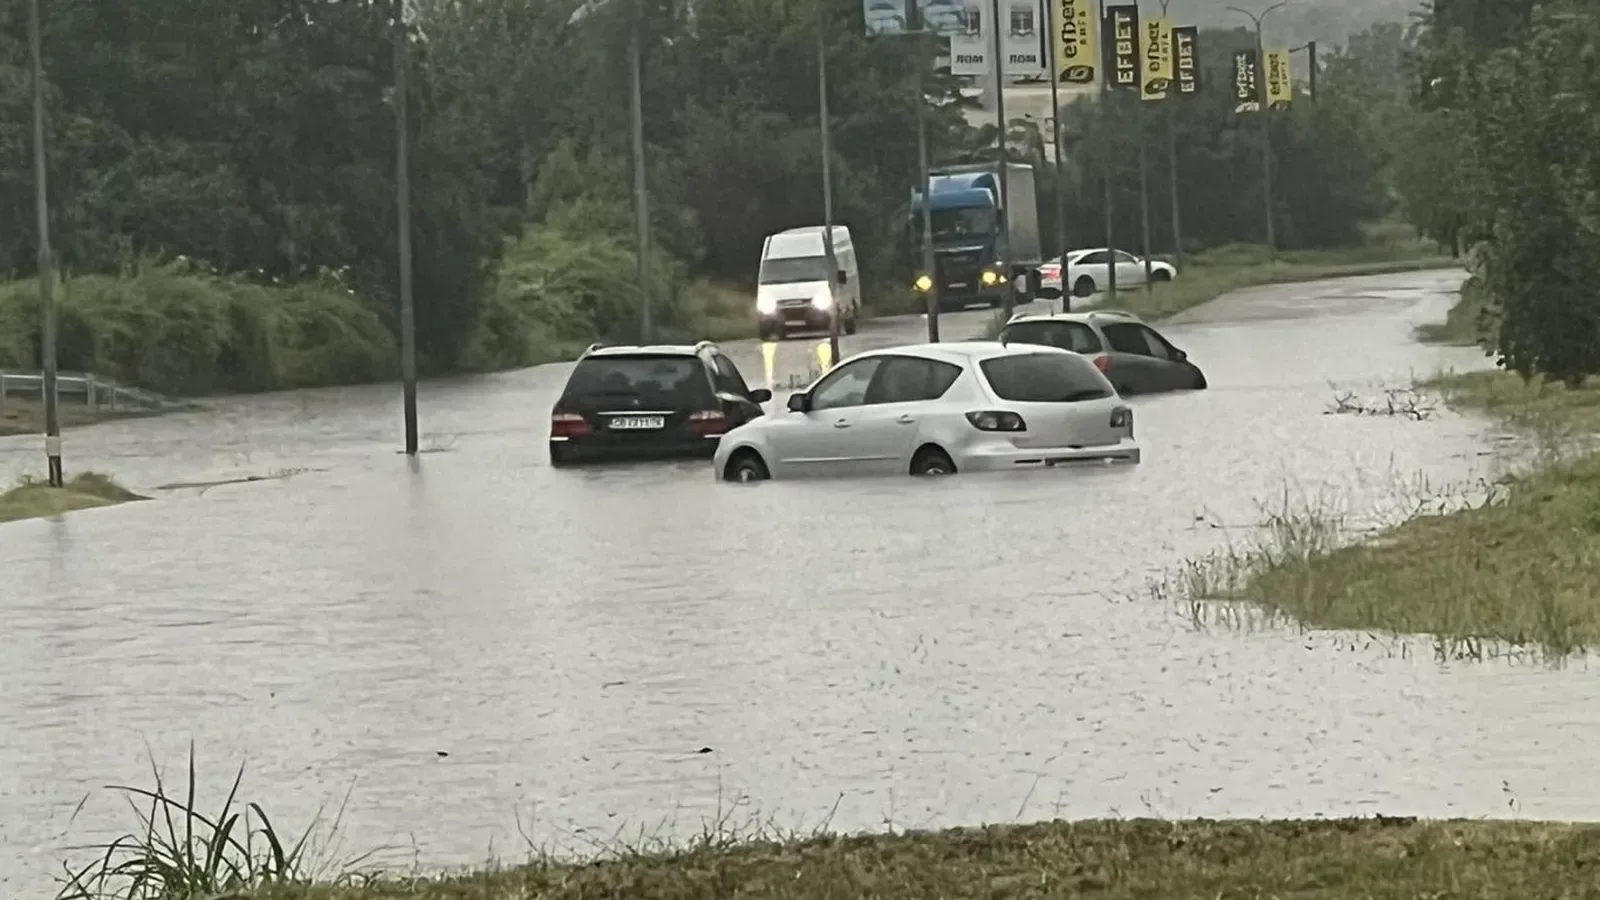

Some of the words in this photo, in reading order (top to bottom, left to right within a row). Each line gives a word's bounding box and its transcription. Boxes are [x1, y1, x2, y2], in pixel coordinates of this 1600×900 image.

[1061, 0, 1077, 58] efbet
[1115, 11, 1134, 84] EFBET
[1148, 22, 1160, 72] efbet
[1177, 32, 1195, 92] EFBET
